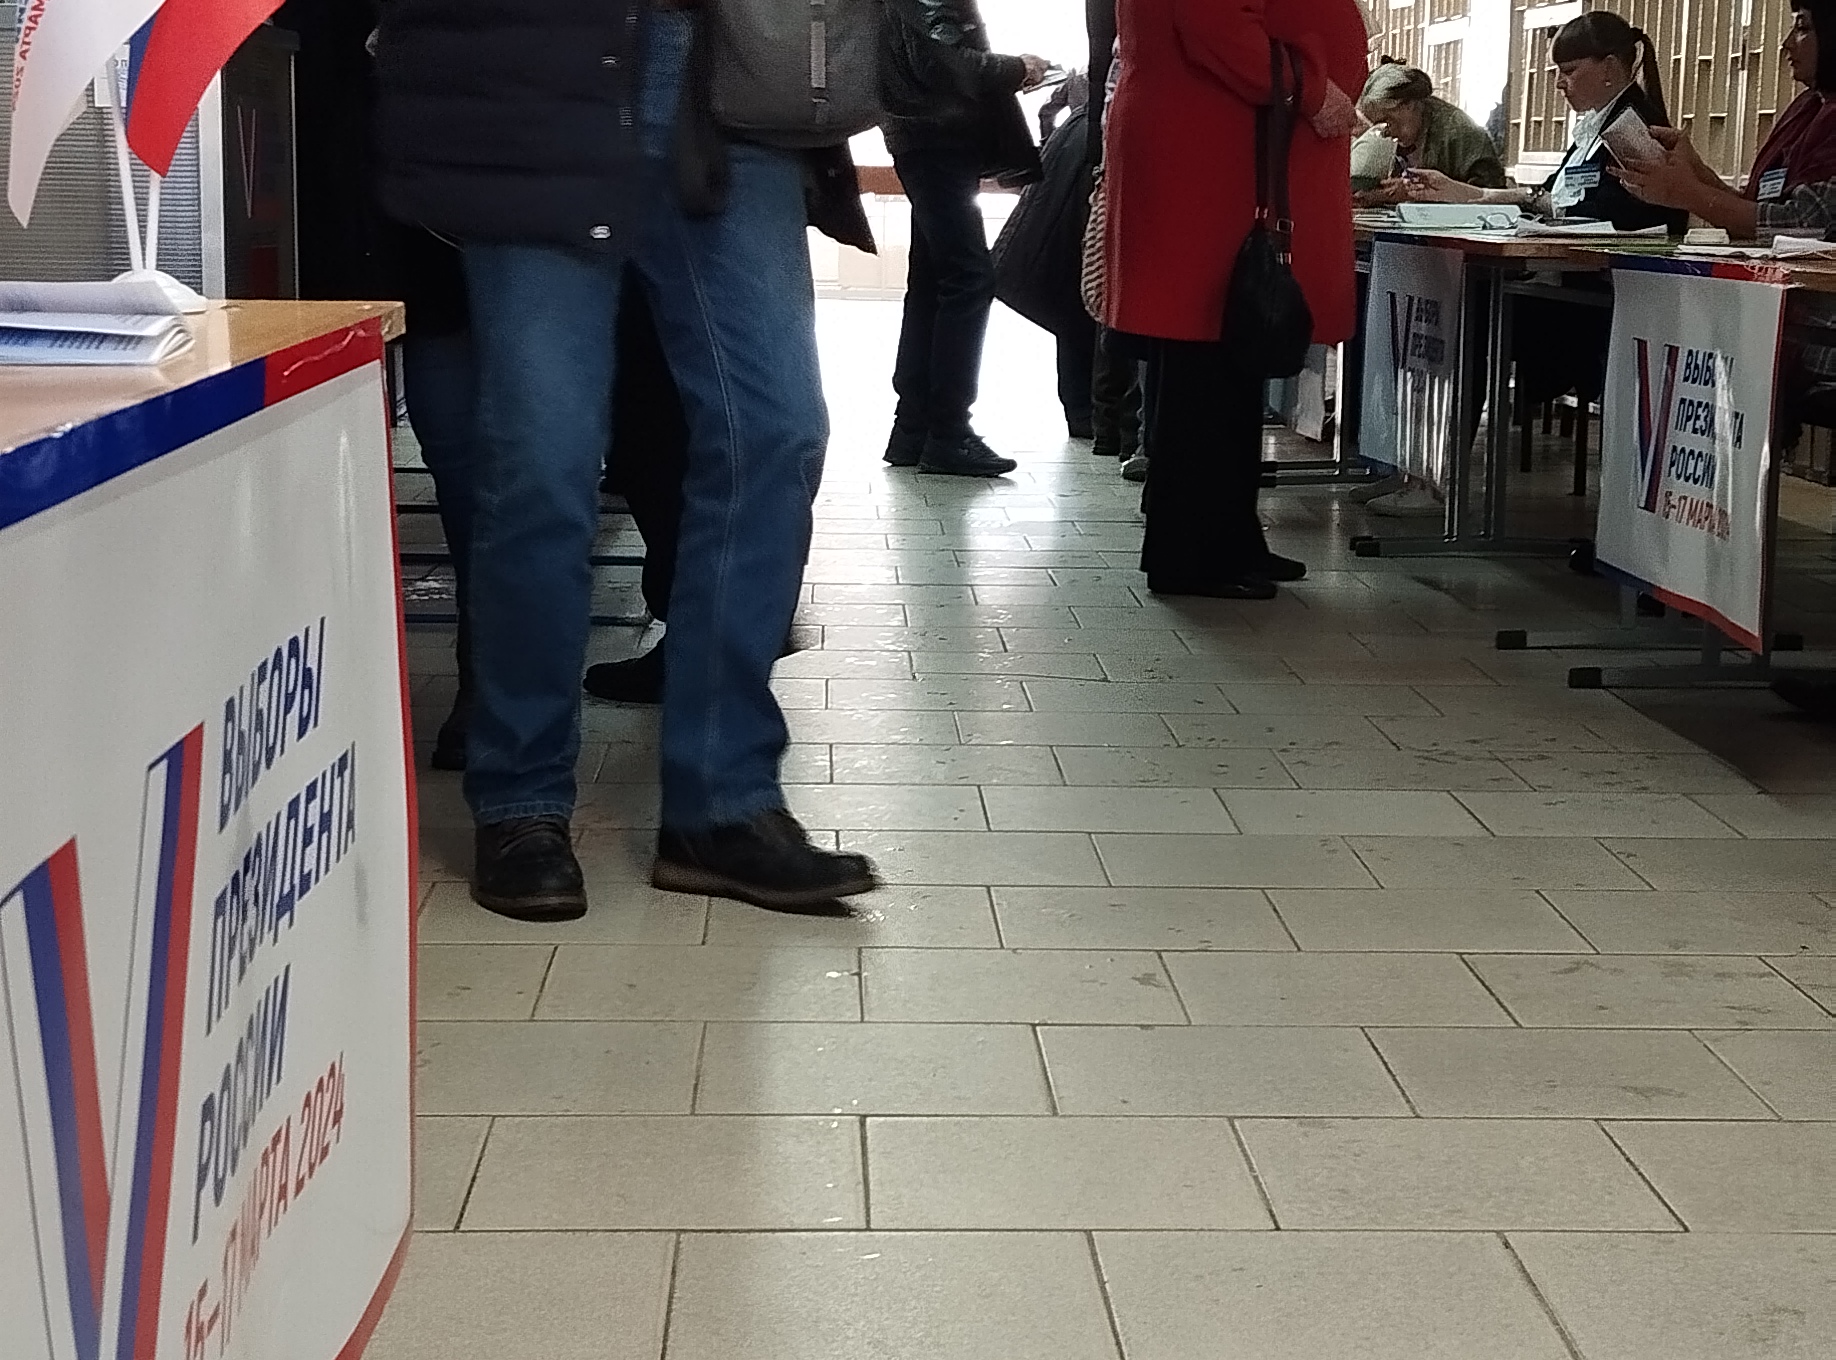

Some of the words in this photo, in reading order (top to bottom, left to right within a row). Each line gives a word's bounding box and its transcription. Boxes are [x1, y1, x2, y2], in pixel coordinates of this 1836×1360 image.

[218, 616, 326, 834] ВЫБОРЫ
[206, 740, 356, 1037] ПРЕЗИДЕНТА
[191, 963, 291, 1246] РОССИИ
[237, 1115, 292, 1317] МАРТА
[294, 1050, 345, 1200] 2024
